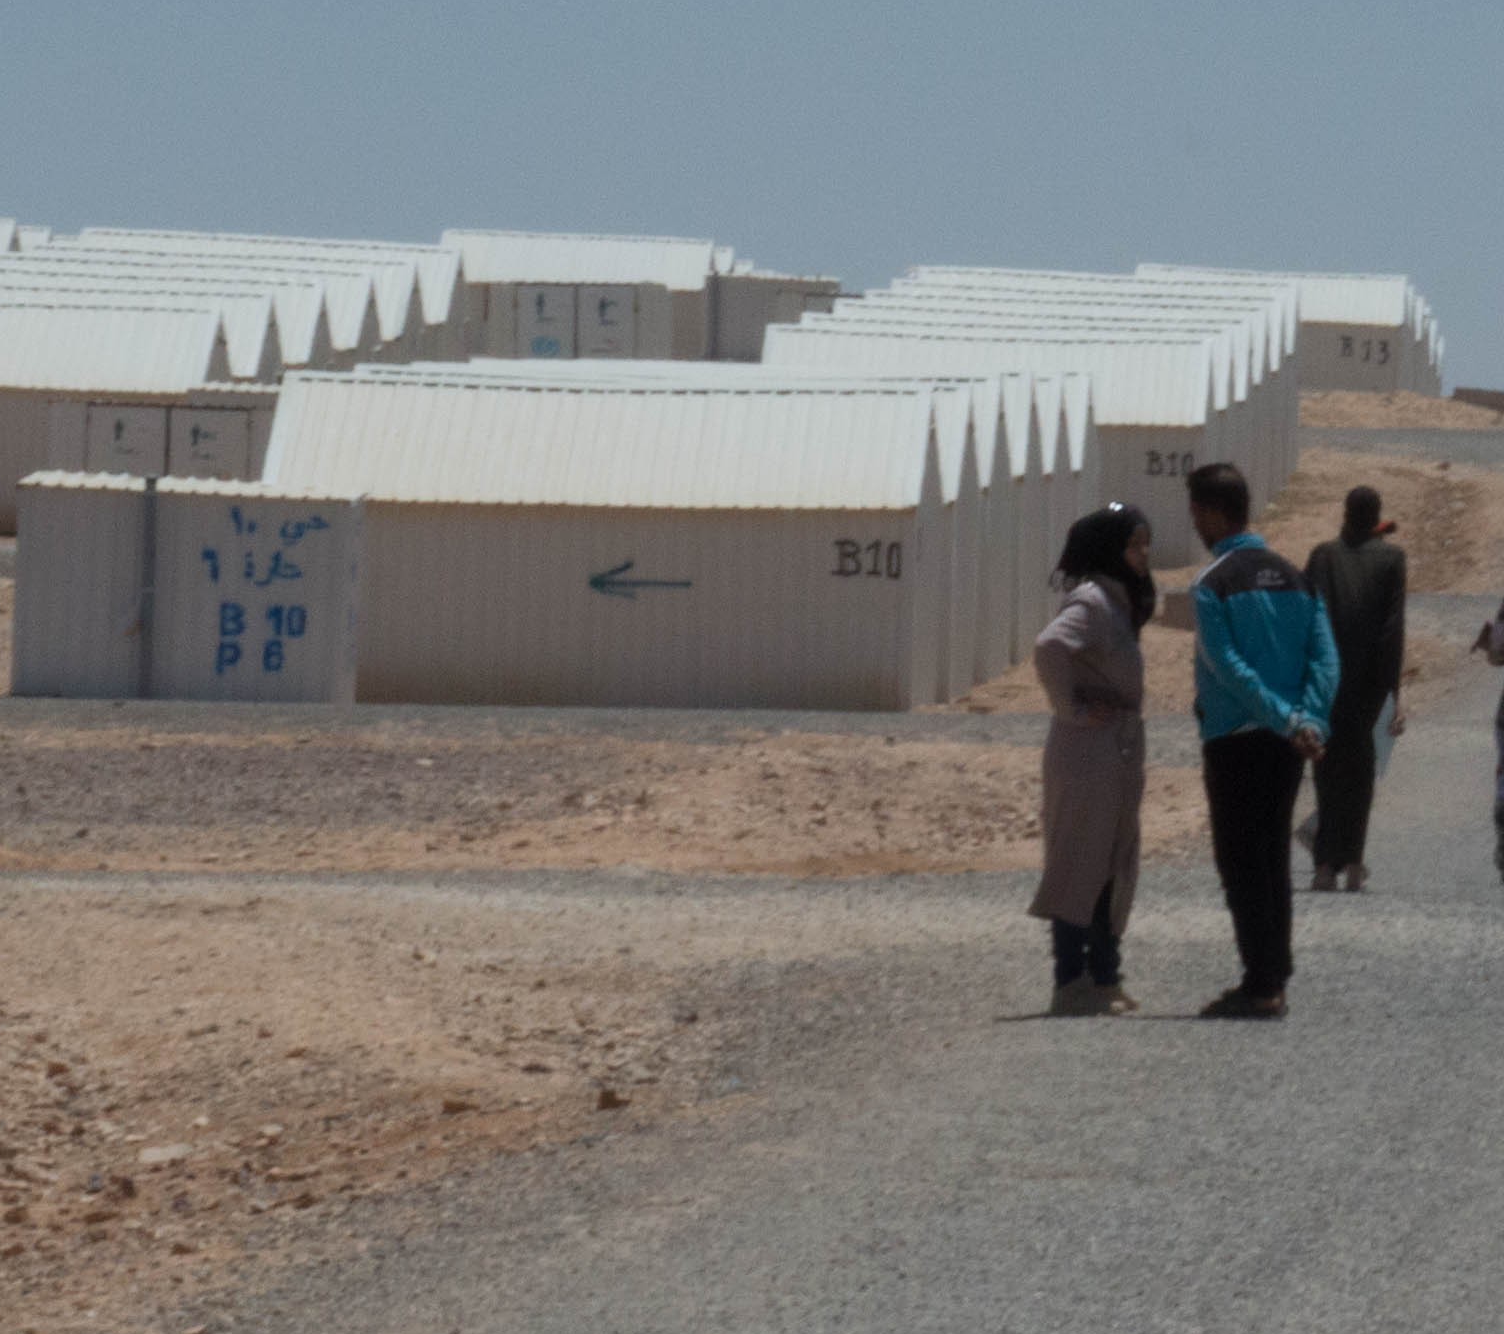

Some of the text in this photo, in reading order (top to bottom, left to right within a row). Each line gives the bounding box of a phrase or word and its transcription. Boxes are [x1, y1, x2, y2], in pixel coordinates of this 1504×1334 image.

[832, 538, 903, 579] B10
[219, 601, 307, 638] B 10
[216, 642, 241, 674] P
